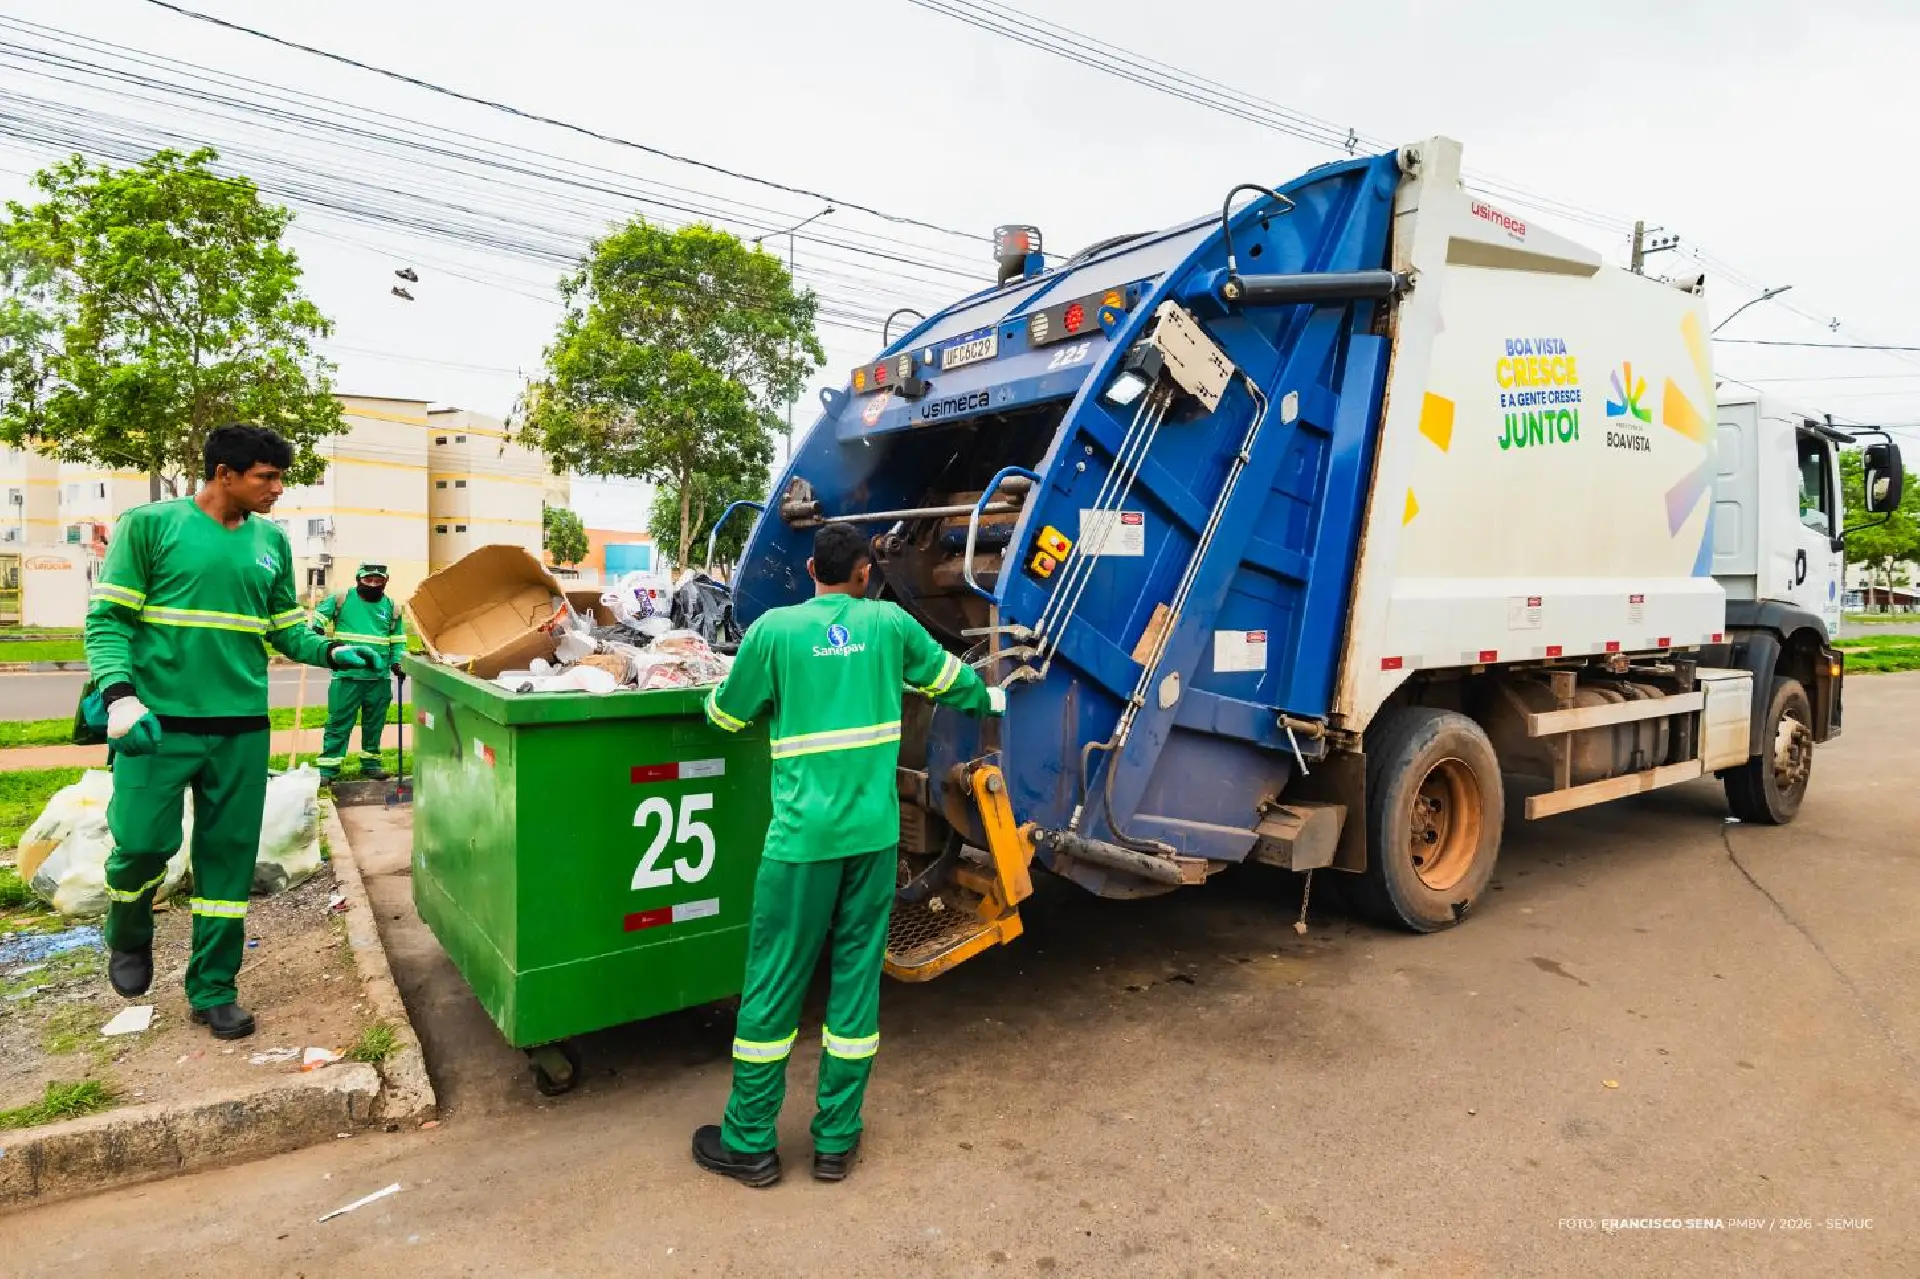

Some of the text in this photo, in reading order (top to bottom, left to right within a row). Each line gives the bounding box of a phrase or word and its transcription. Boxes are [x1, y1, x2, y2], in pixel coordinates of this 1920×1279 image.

[1471, 201, 1526, 236] usimeca
[1047, 341, 1092, 370] 225
[1505, 337, 1567, 356] BOA VISTA
[1496, 355, 1579, 389] CRESCE
[921, 392, 990, 419] usimeca
[1500, 389, 1582, 407] E A GENTE CRESCE
[1498, 408, 1580, 450] JUNTO!
[812, 643, 866, 657] Sanepav
[630, 792, 716, 891] 25
